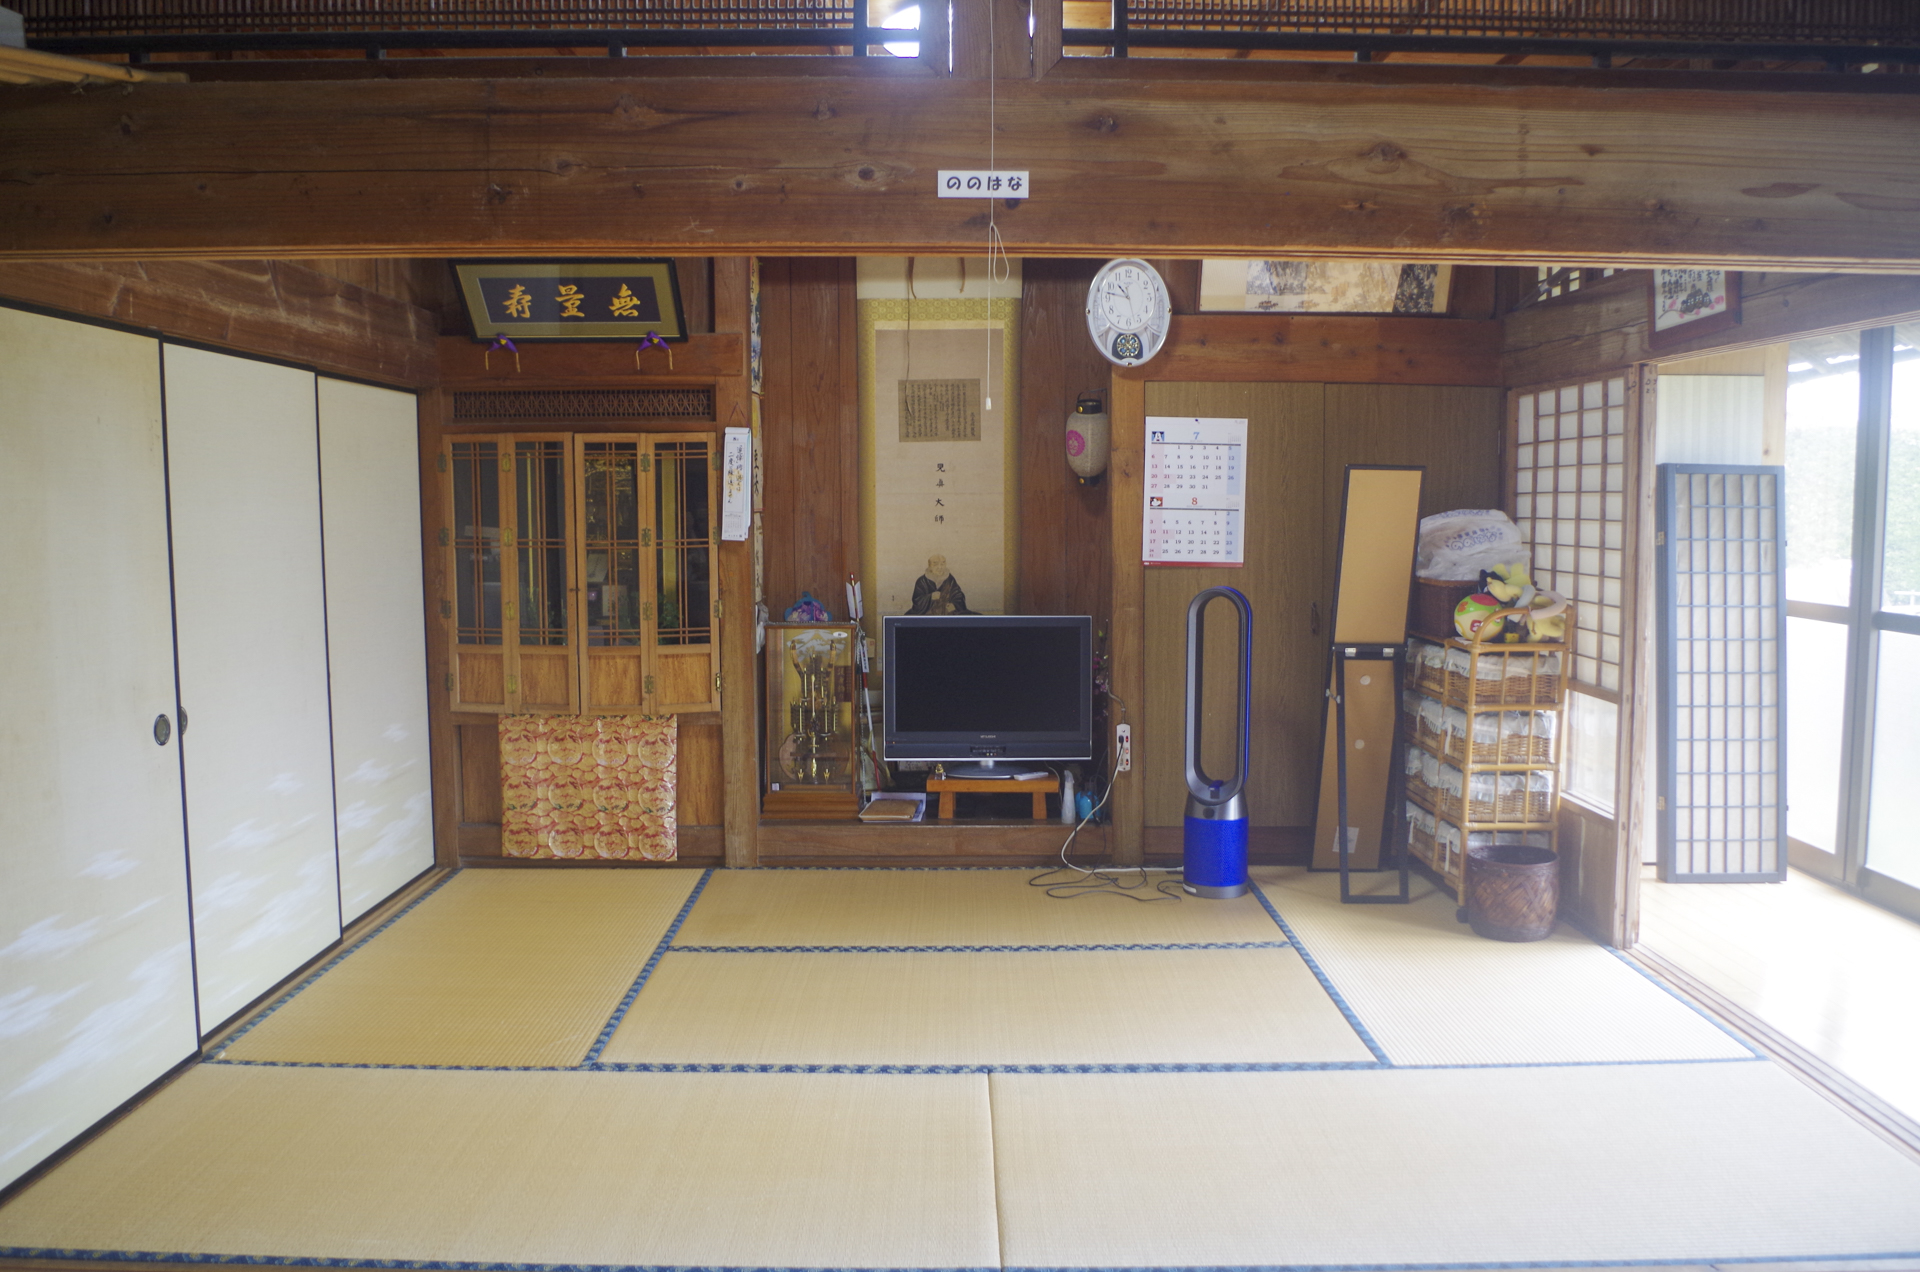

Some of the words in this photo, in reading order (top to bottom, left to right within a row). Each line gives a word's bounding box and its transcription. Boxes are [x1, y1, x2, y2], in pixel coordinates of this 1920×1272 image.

[946, 176, 1022, 191] ののはな
[1115, 273, 1120, 281] 11
[1125, 269, 1132, 278] 12
[1144, 281, 1148, 289] 2
[1147, 294, 1152, 302] 3
[1109, 306, 1114, 314] 8
[1144, 305, 1148, 313] 4
[1117, 315, 1121, 324] 7
[1126, 318, 1131, 327] 6
[1137, 315, 1142, 323] 5
[1193, 431, 1200, 440] 7
[1191, 497, 1198, 505] 8
[1451, 532, 1497, 550] ののはな
